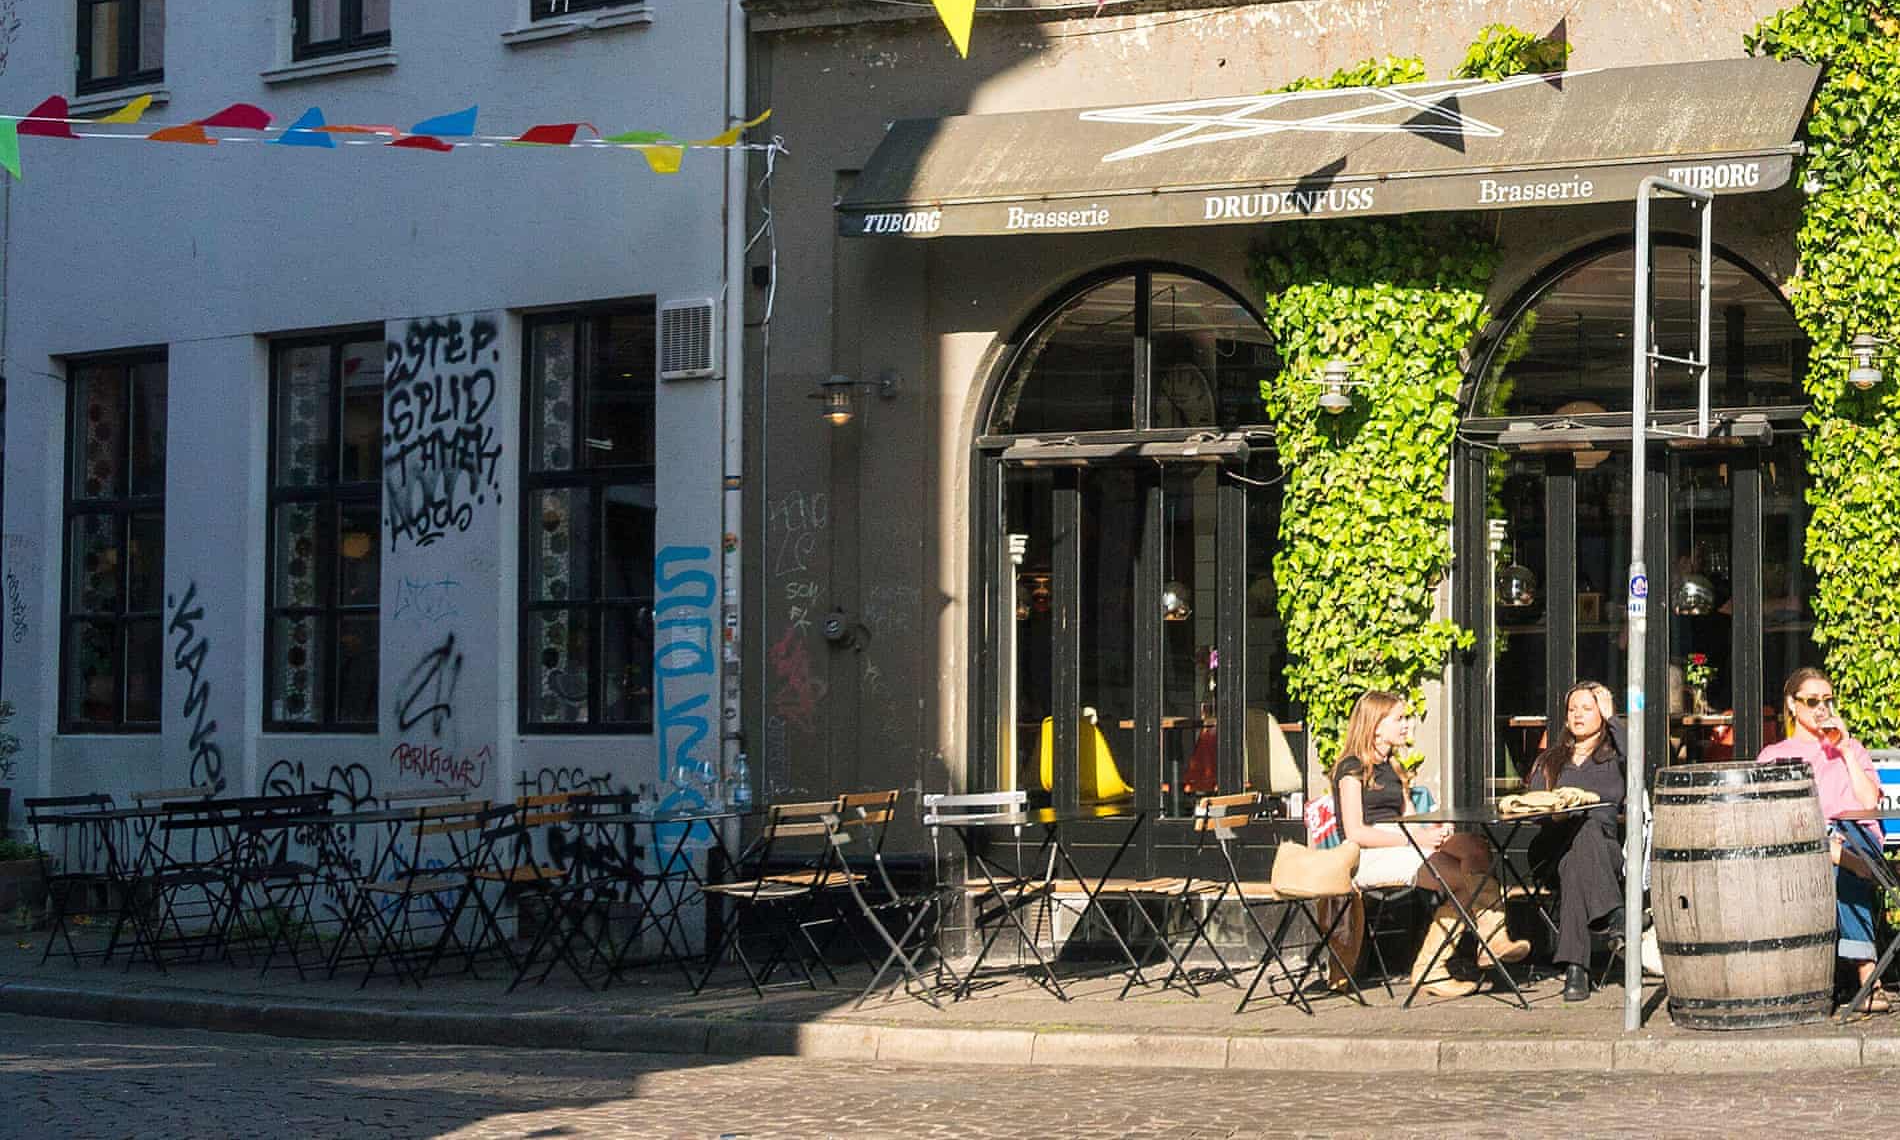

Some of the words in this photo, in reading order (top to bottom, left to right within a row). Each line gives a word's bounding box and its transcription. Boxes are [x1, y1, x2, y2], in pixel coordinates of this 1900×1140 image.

[863, 210, 942, 233] TUBORG
[1006, 203, 1110, 229] Brasserie
[1204, 187, 1374, 220] DRUDENFUSS
[1477, 173, 1593, 204] Brasserie
[1668, 162, 1760, 189] TUBORG
